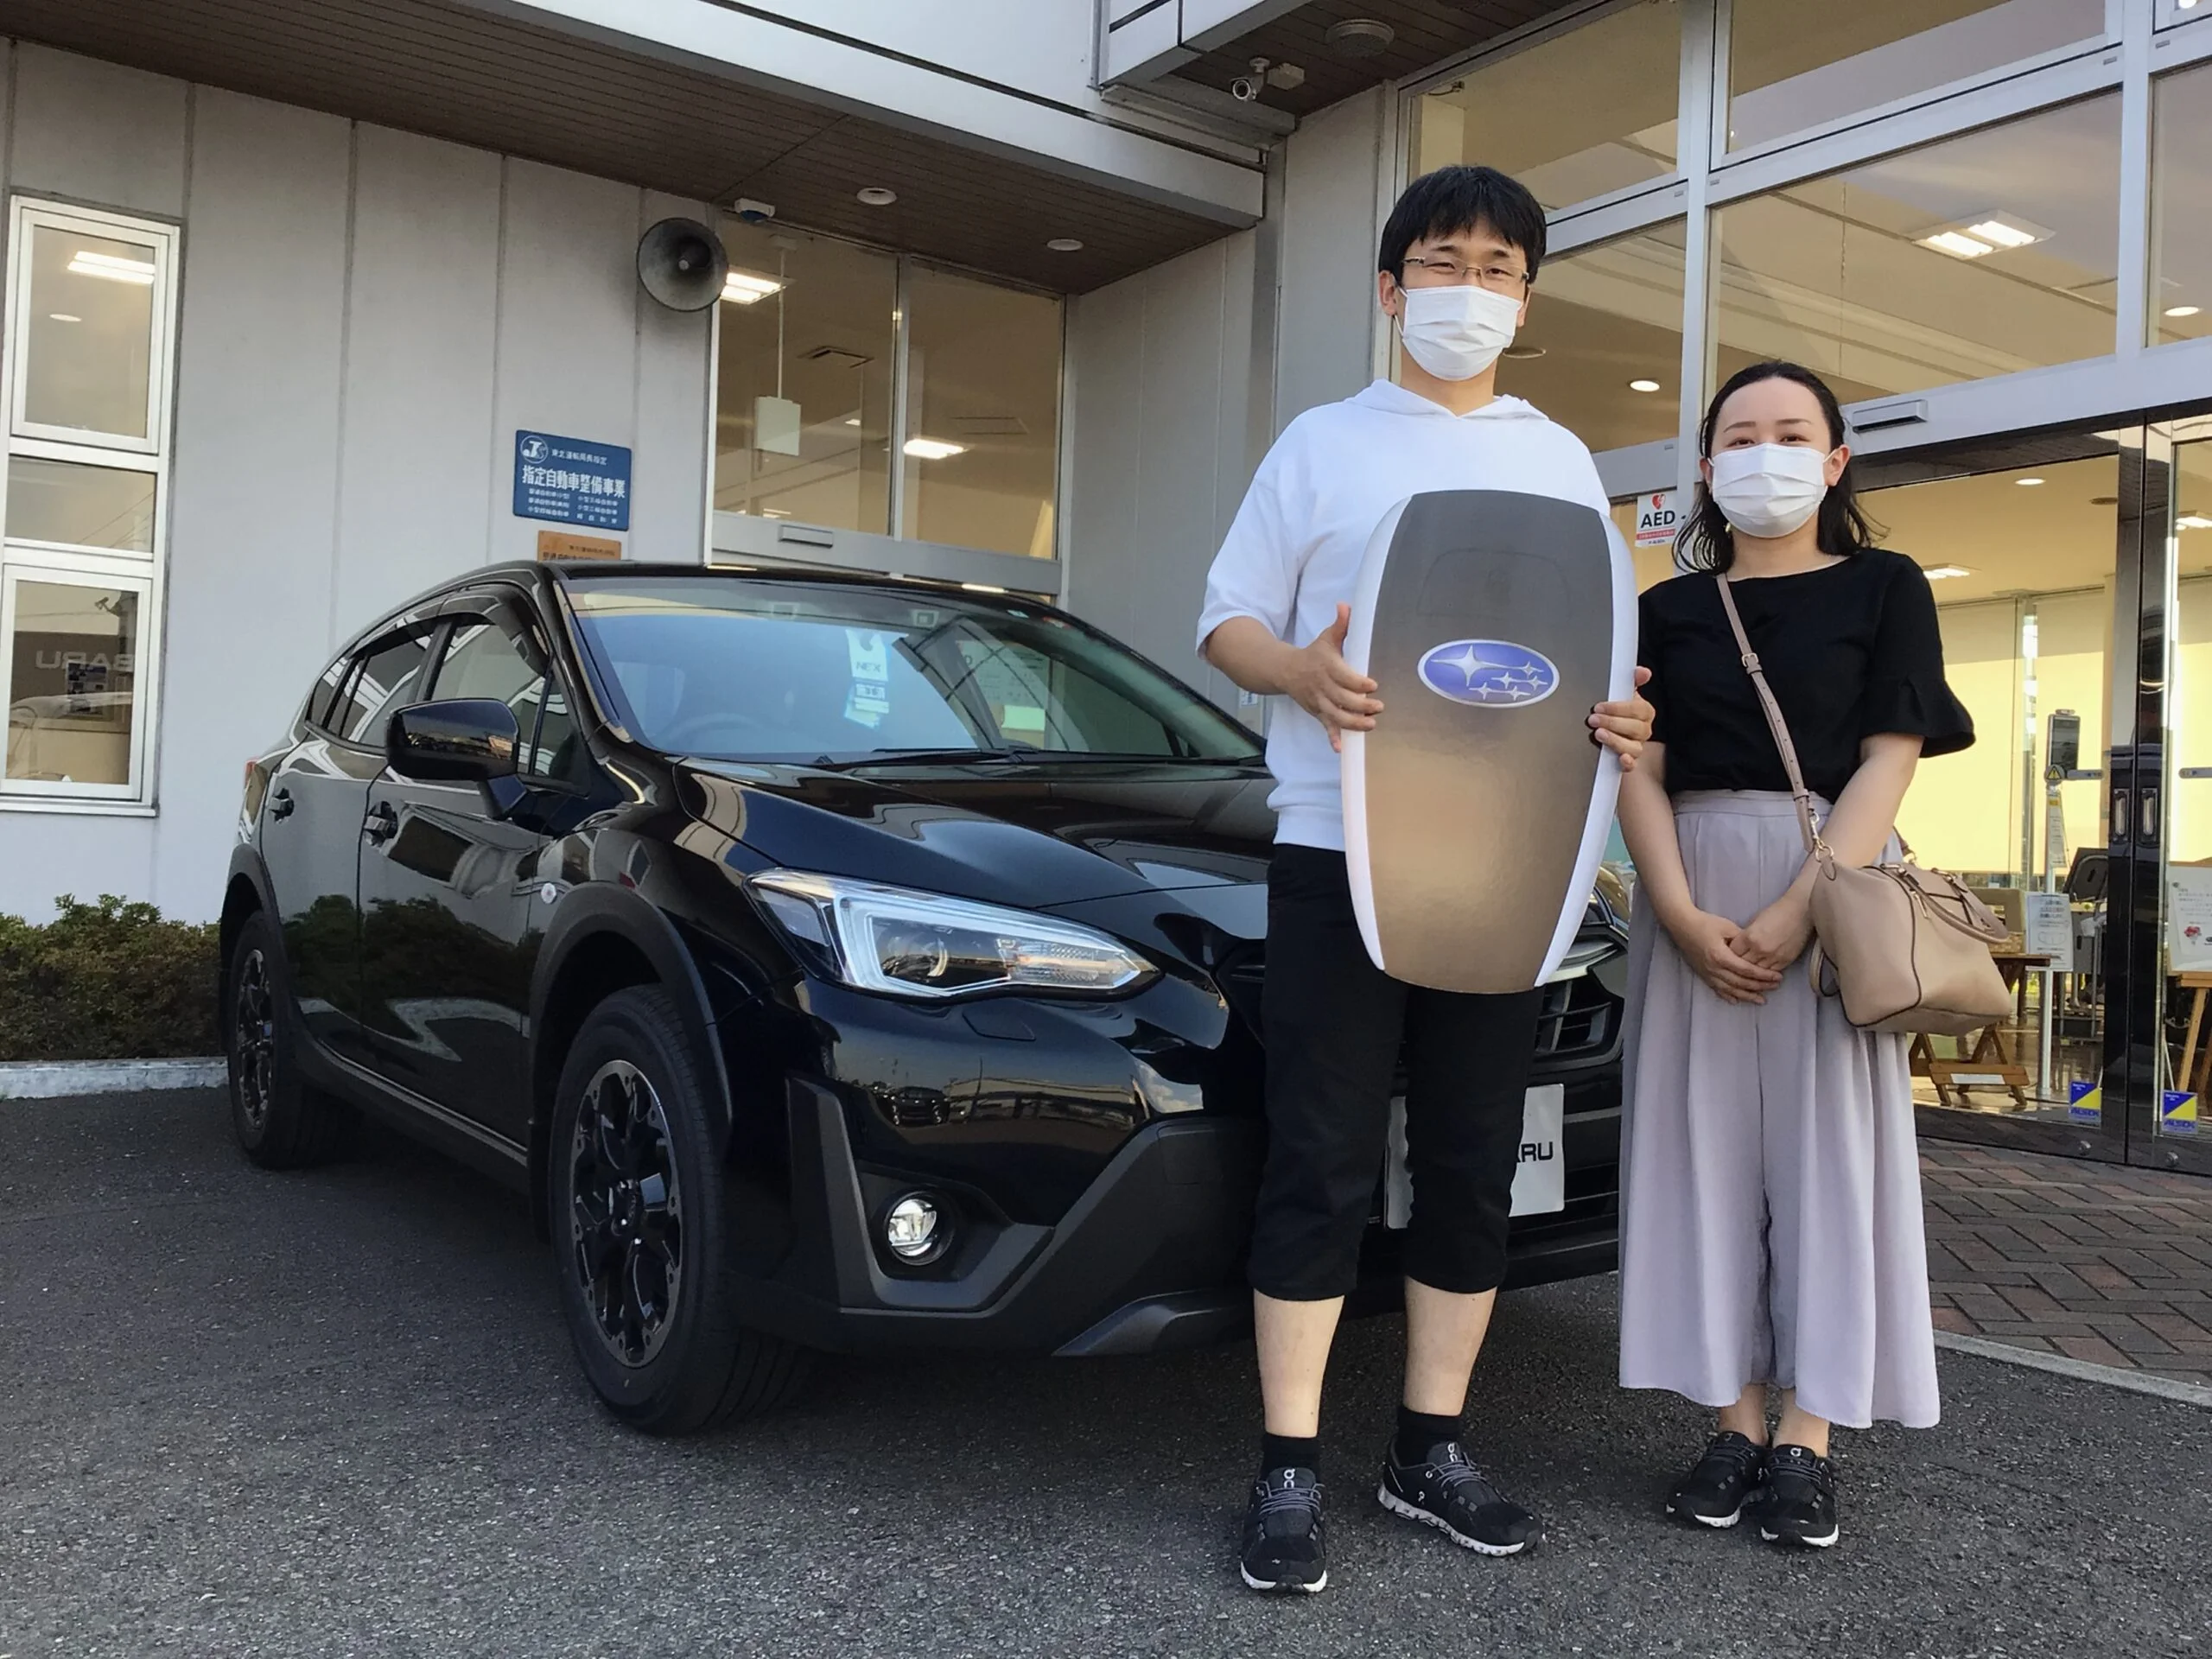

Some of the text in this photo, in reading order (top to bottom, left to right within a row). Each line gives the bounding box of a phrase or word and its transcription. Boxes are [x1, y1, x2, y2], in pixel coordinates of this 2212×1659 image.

[522, 465, 626, 499] 指定自動車整備事業
[1640, 510, 1675, 529] AED
[1518, 1141, 1554, 1162] RU
